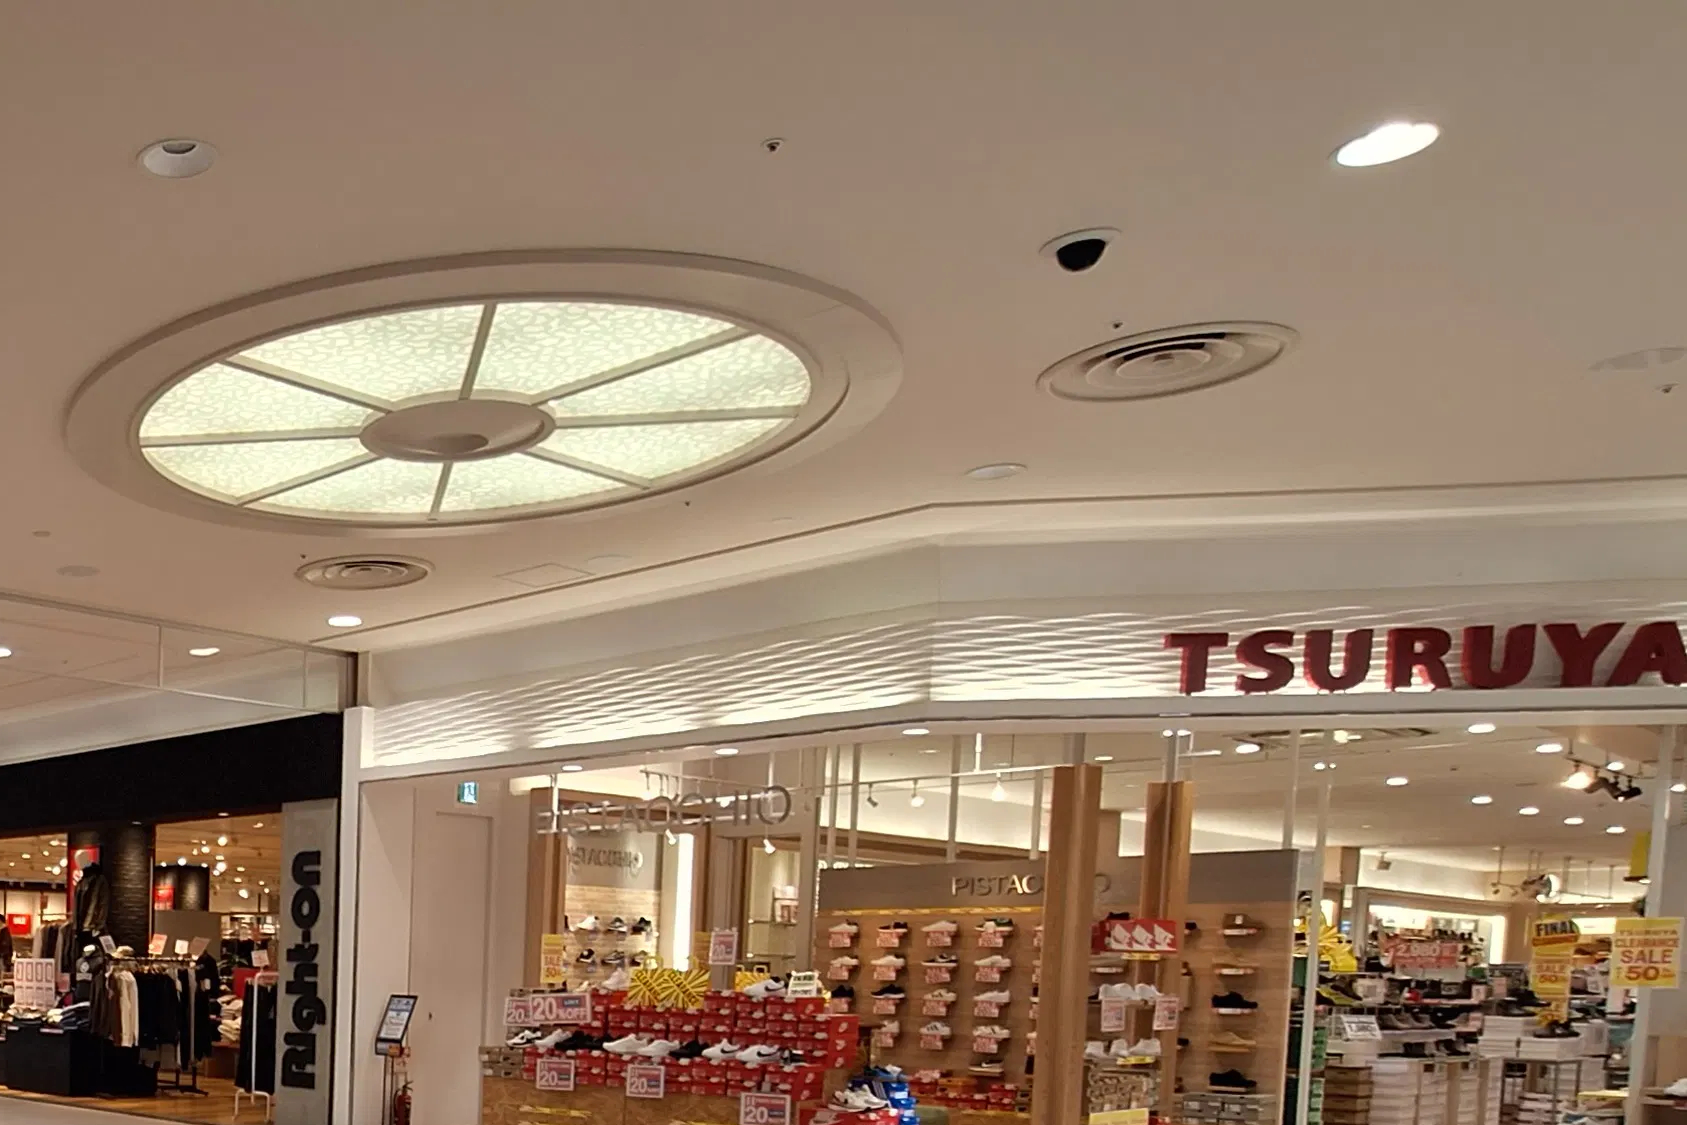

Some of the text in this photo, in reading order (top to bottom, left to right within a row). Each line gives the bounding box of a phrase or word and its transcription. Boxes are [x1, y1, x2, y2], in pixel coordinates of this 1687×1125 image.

[1164, 621, 1687, 696] TSURUYA
[1536, 920, 1575, 937] FINAL
[1621, 950, 1673, 964] SALE
[1625, 966, 1660, 981] 50
[507, 1009, 525, 1022] 20
[533, 997, 557, 1020] 20
[540, 1070, 558, 1085] 20
[630, 1078, 648, 1092] 20
[745, 1106, 769, 1123] 20
